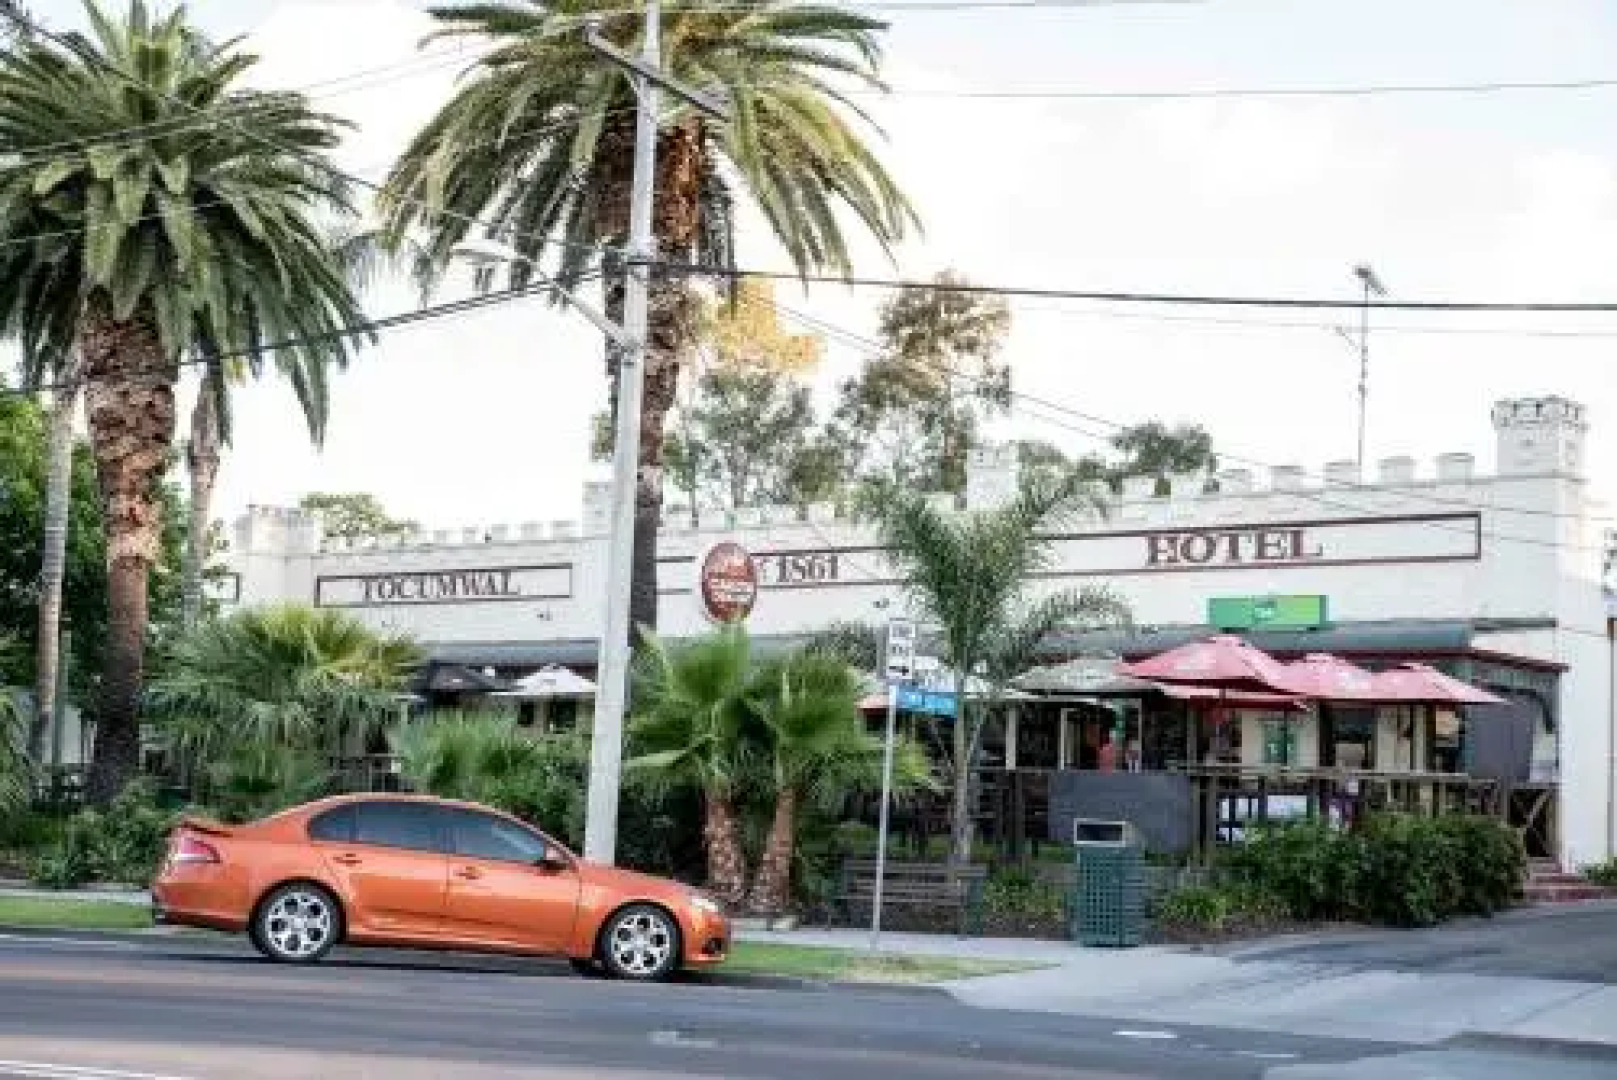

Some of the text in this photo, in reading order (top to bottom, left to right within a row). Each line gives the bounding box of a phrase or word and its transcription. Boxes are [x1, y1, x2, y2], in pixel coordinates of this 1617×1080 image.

[1147, 530, 1323, 567] HOTEL
[776, 555, 838, 583] 1861
[361, 570, 519, 601] TOCUMWAL
